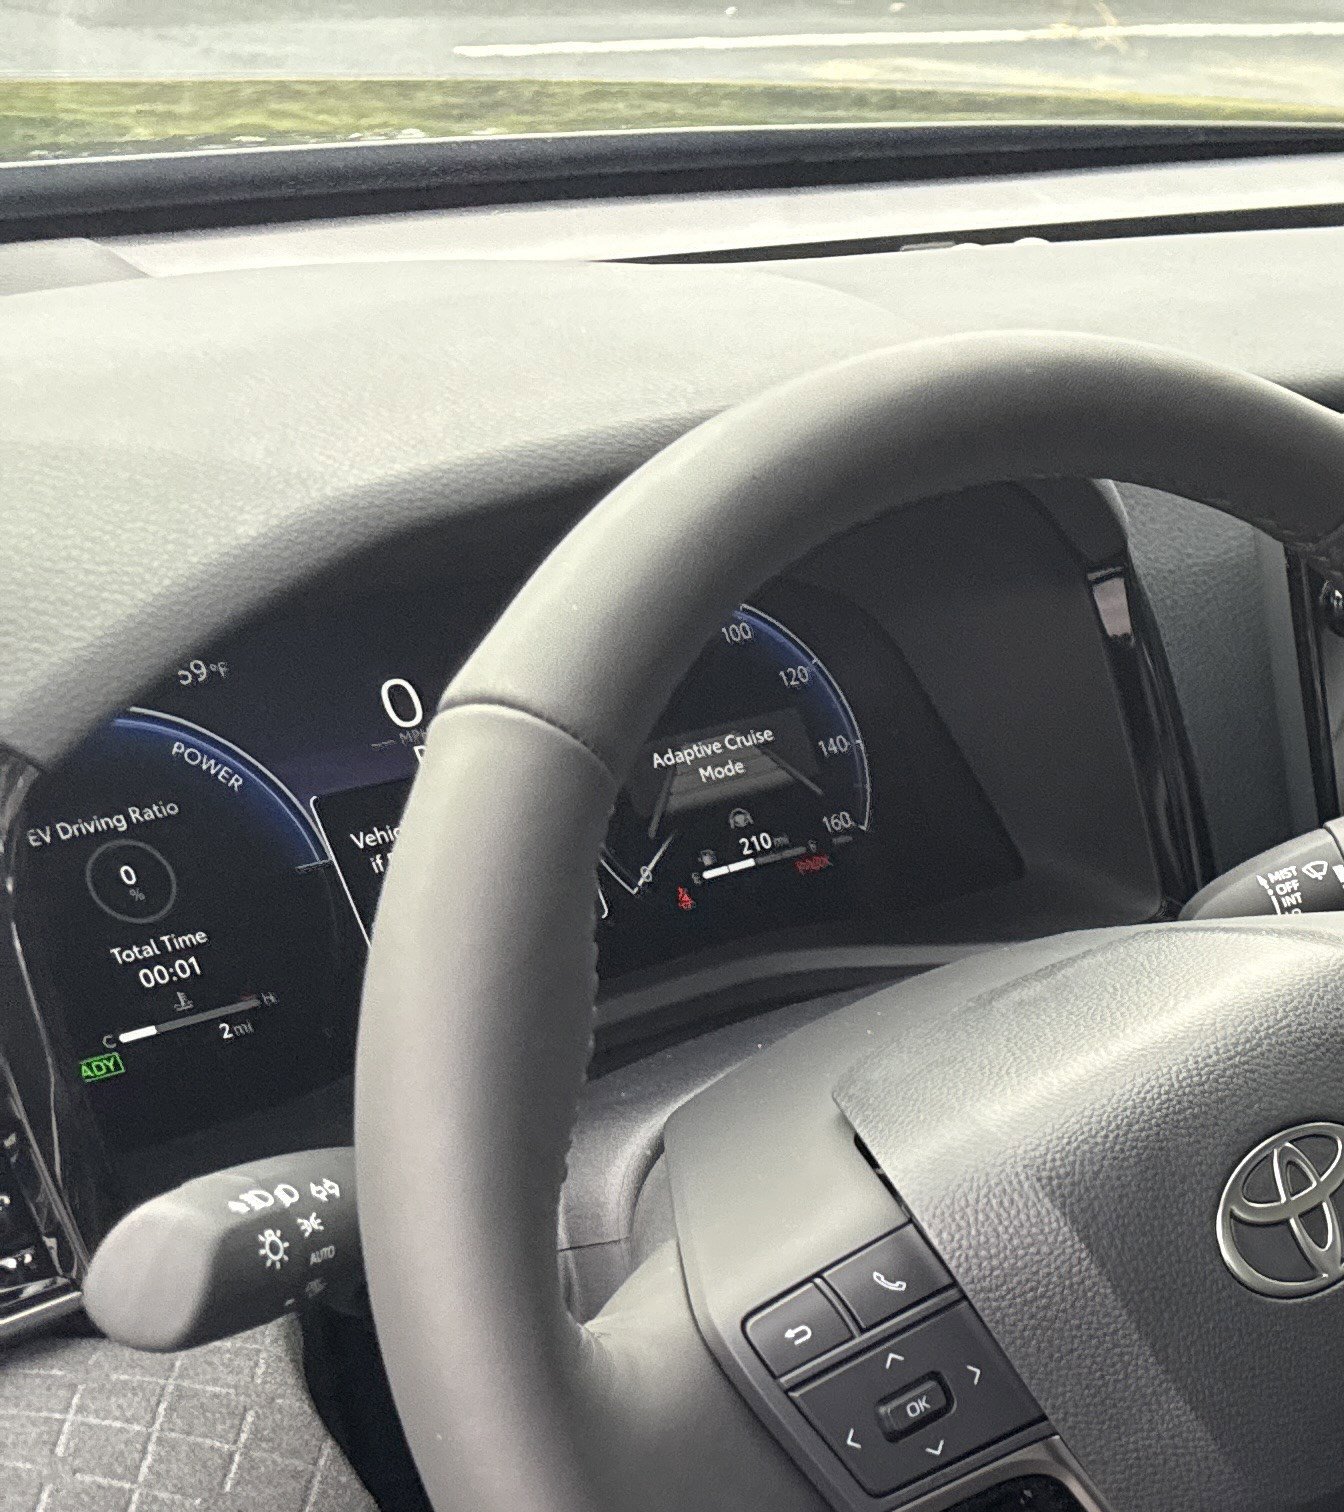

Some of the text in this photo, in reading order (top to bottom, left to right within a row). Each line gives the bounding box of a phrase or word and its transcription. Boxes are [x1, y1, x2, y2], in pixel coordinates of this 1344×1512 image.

[721, 622, 751, 645] 100
[778, 665, 810, 688] 120
[381, 678, 424, 728] 0
[652, 727, 775, 770] Adaptive Cruise
[818, 735, 848, 758] 140
[171, 741, 244, 793] POWER
[699, 759, 745, 784] Mode
[27, 799, 180, 848] EV Driving Ratio
[822, 811, 852, 834] 160
[738, 831, 773, 856] 210
[119, 865, 138, 886] 0
[1267, 865, 1298, 884] MIST
[1275, 879, 1300, 896] OFF
[1281, 891, 1303, 908] INT
[110, 928, 208, 967] Total Time
[137, 956, 203, 989] 00:01
[102, 1034, 117, 1049] C
[218, 1022, 234, 1040] 2
[80, 1058, 117, 1080] ADY
[309, 1245, 335, 1266] AUTO
[906, 1394, 931, 1418] OK
